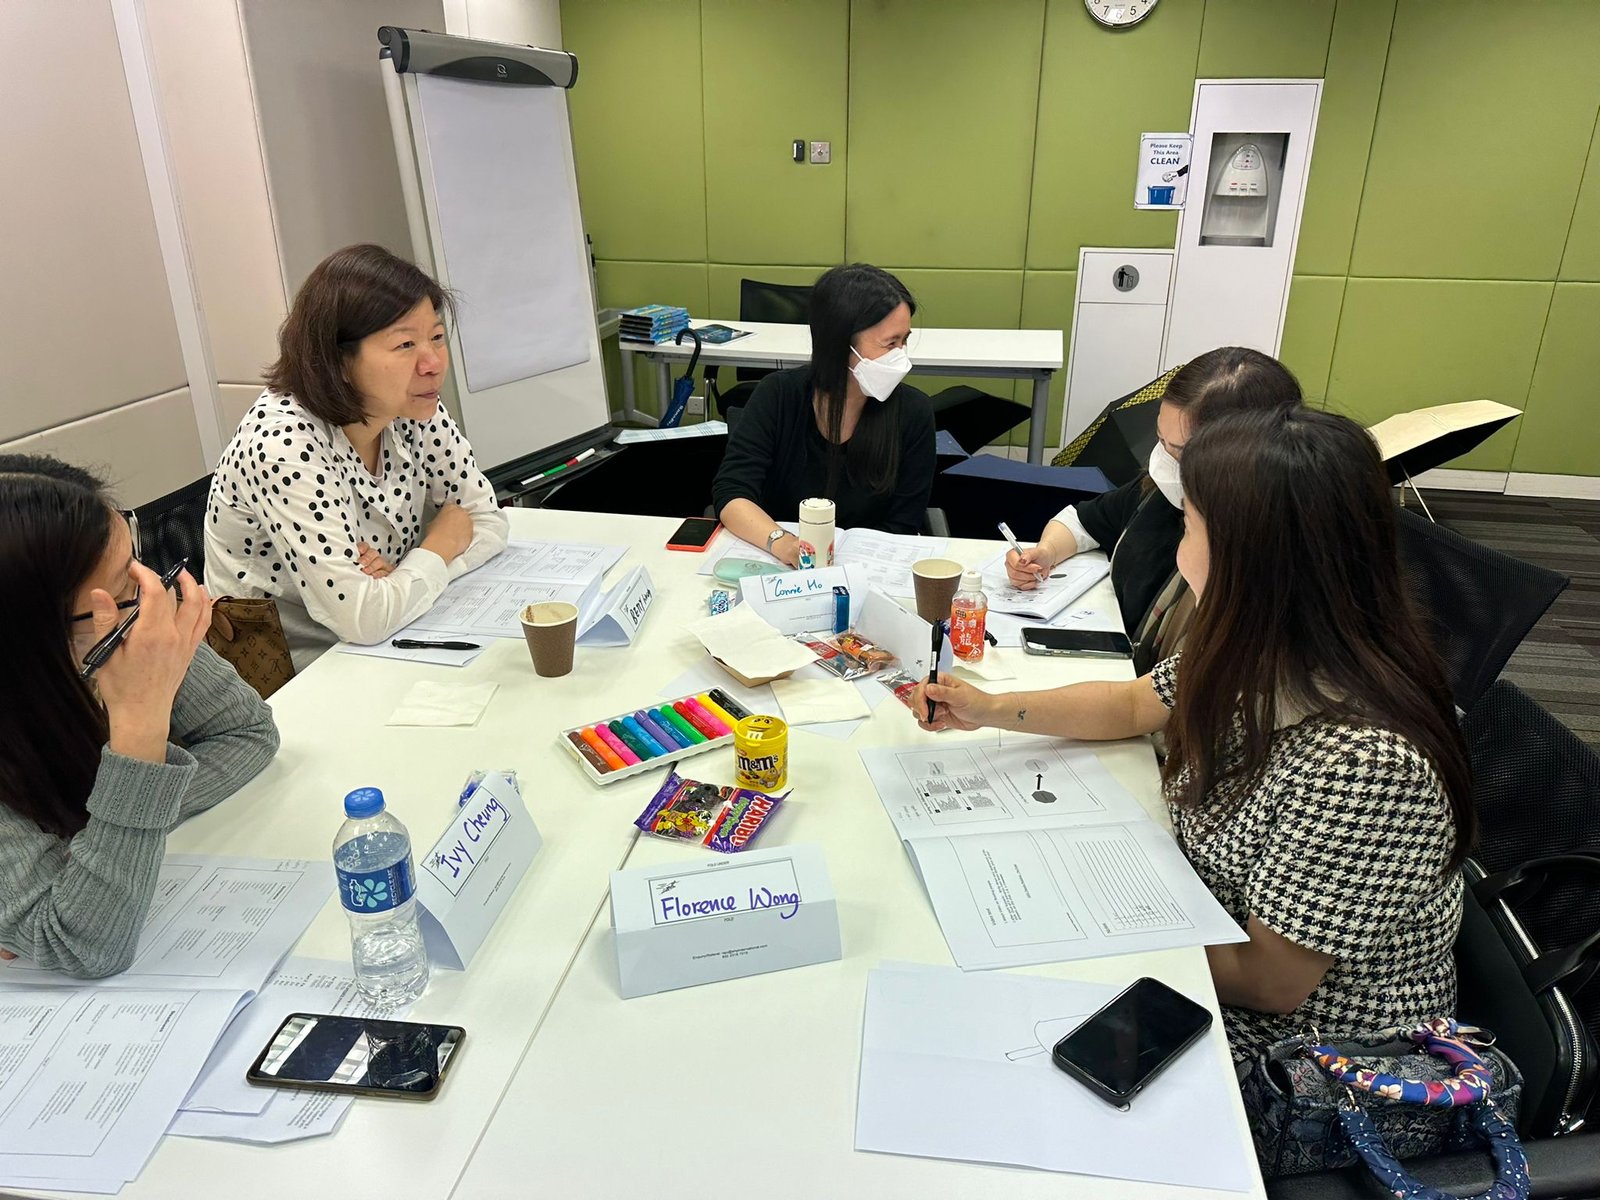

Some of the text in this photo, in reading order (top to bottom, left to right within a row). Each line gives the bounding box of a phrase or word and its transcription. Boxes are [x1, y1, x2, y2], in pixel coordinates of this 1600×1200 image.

[1103, 5, 1110, 15] 7
[1129, 5, 1137, 16] 5
[775, 578, 803, 597] Connie
[729, 795, 774, 847] HARIBO
[440, 839, 475, 879] Ivy
[463, 797, 509, 843] Cheung
[661, 886, 799, 921] Florence Wong
